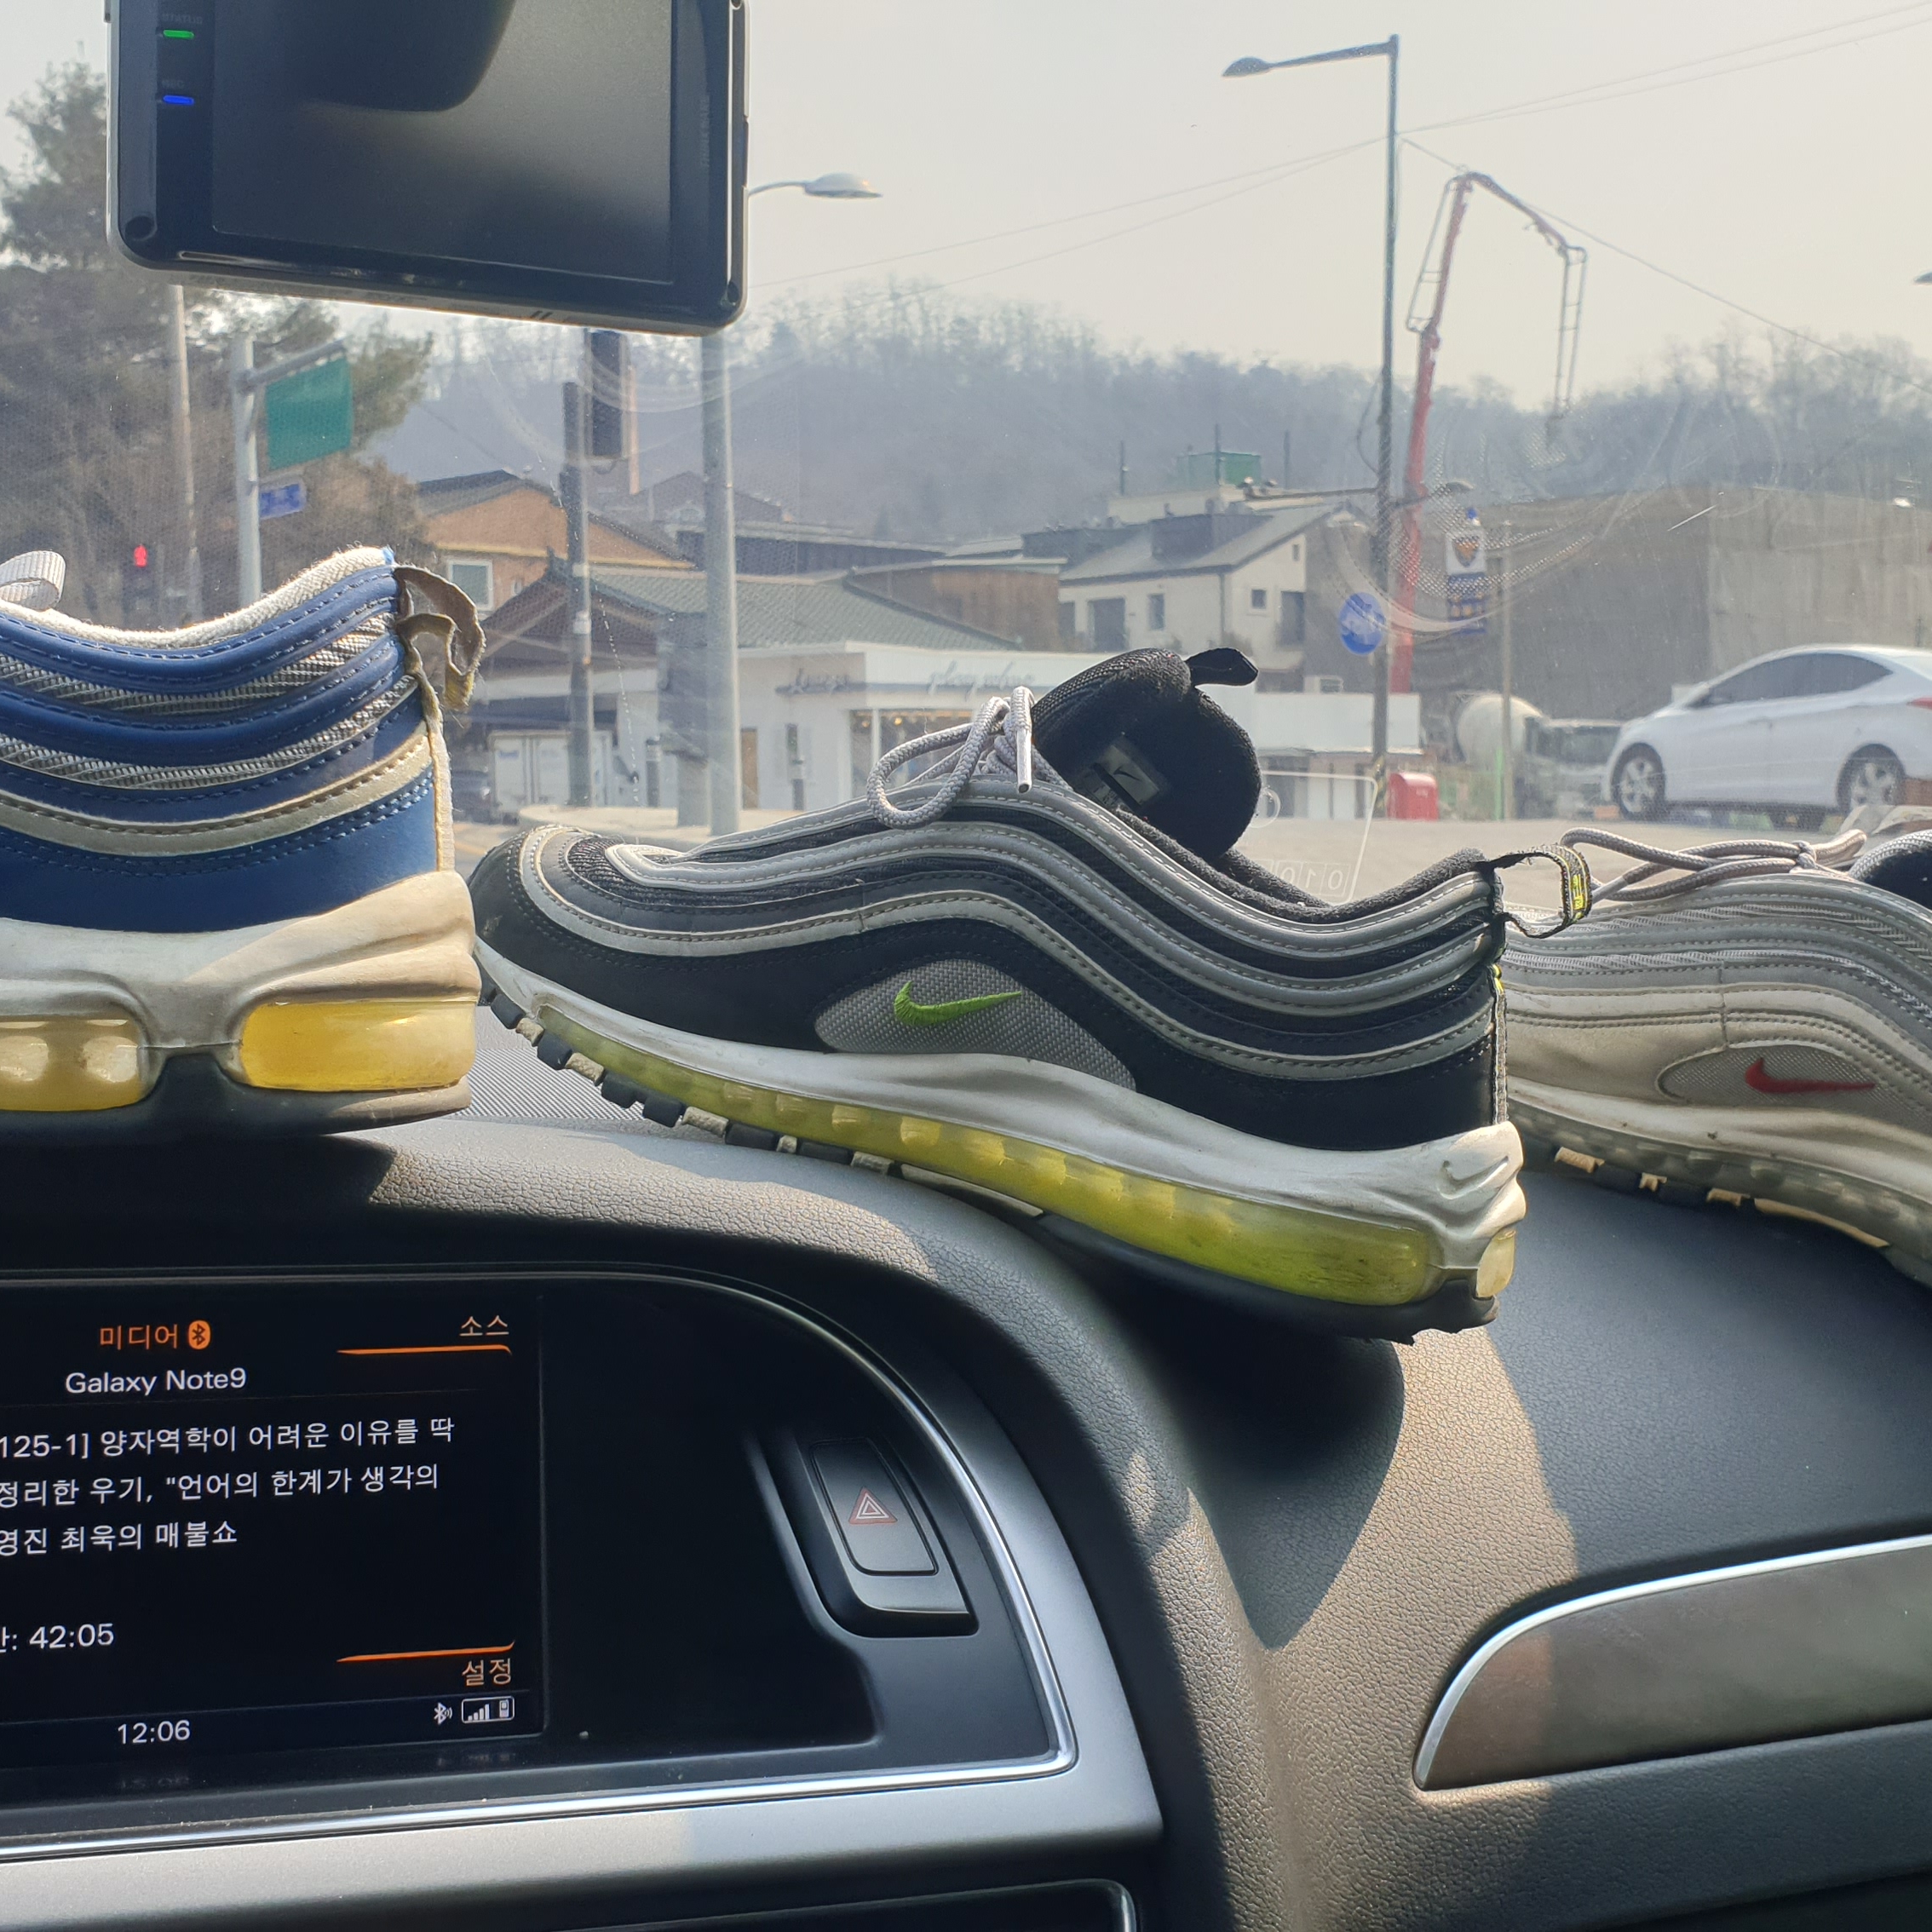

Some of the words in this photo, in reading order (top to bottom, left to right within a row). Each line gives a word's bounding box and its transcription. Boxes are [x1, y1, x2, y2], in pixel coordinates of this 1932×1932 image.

[101, 1325, 177, 1349] 미디어
[460, 1315, 509, 1336] 소스
[66, 1372, 157, 1395] Galaxy
[167, 1367, 246, 1390] Note9
[0, 1434, 89, 1458] 125-1]
[101, 1426, 235, 1456] 양자역학이
[250, 1423, 329, 1450] 어려운
[341, 1419, 418, 1446] 이유를
[431, 1417, 454, 1441] 딱
[0, 1480, 79, 1508] 정리한
[90, 1477, 152, 1504] 우기,
[167, 1472, 256, 1499] "언어의
[272, 1468, 352, 1495] 한계가
[361, 1464, 437, 1492] 생각의
[0, 1528, 46, 1555] 영진
[61, 1524, 141, 1552] 최욱의
[156, 1521, 237, 1548] 매불쇼
[30, 1624, 113, 1648] 42:05
[463, 1659, 510, 1686] 설정
[118, 1720, 190, 1744] 12:06
